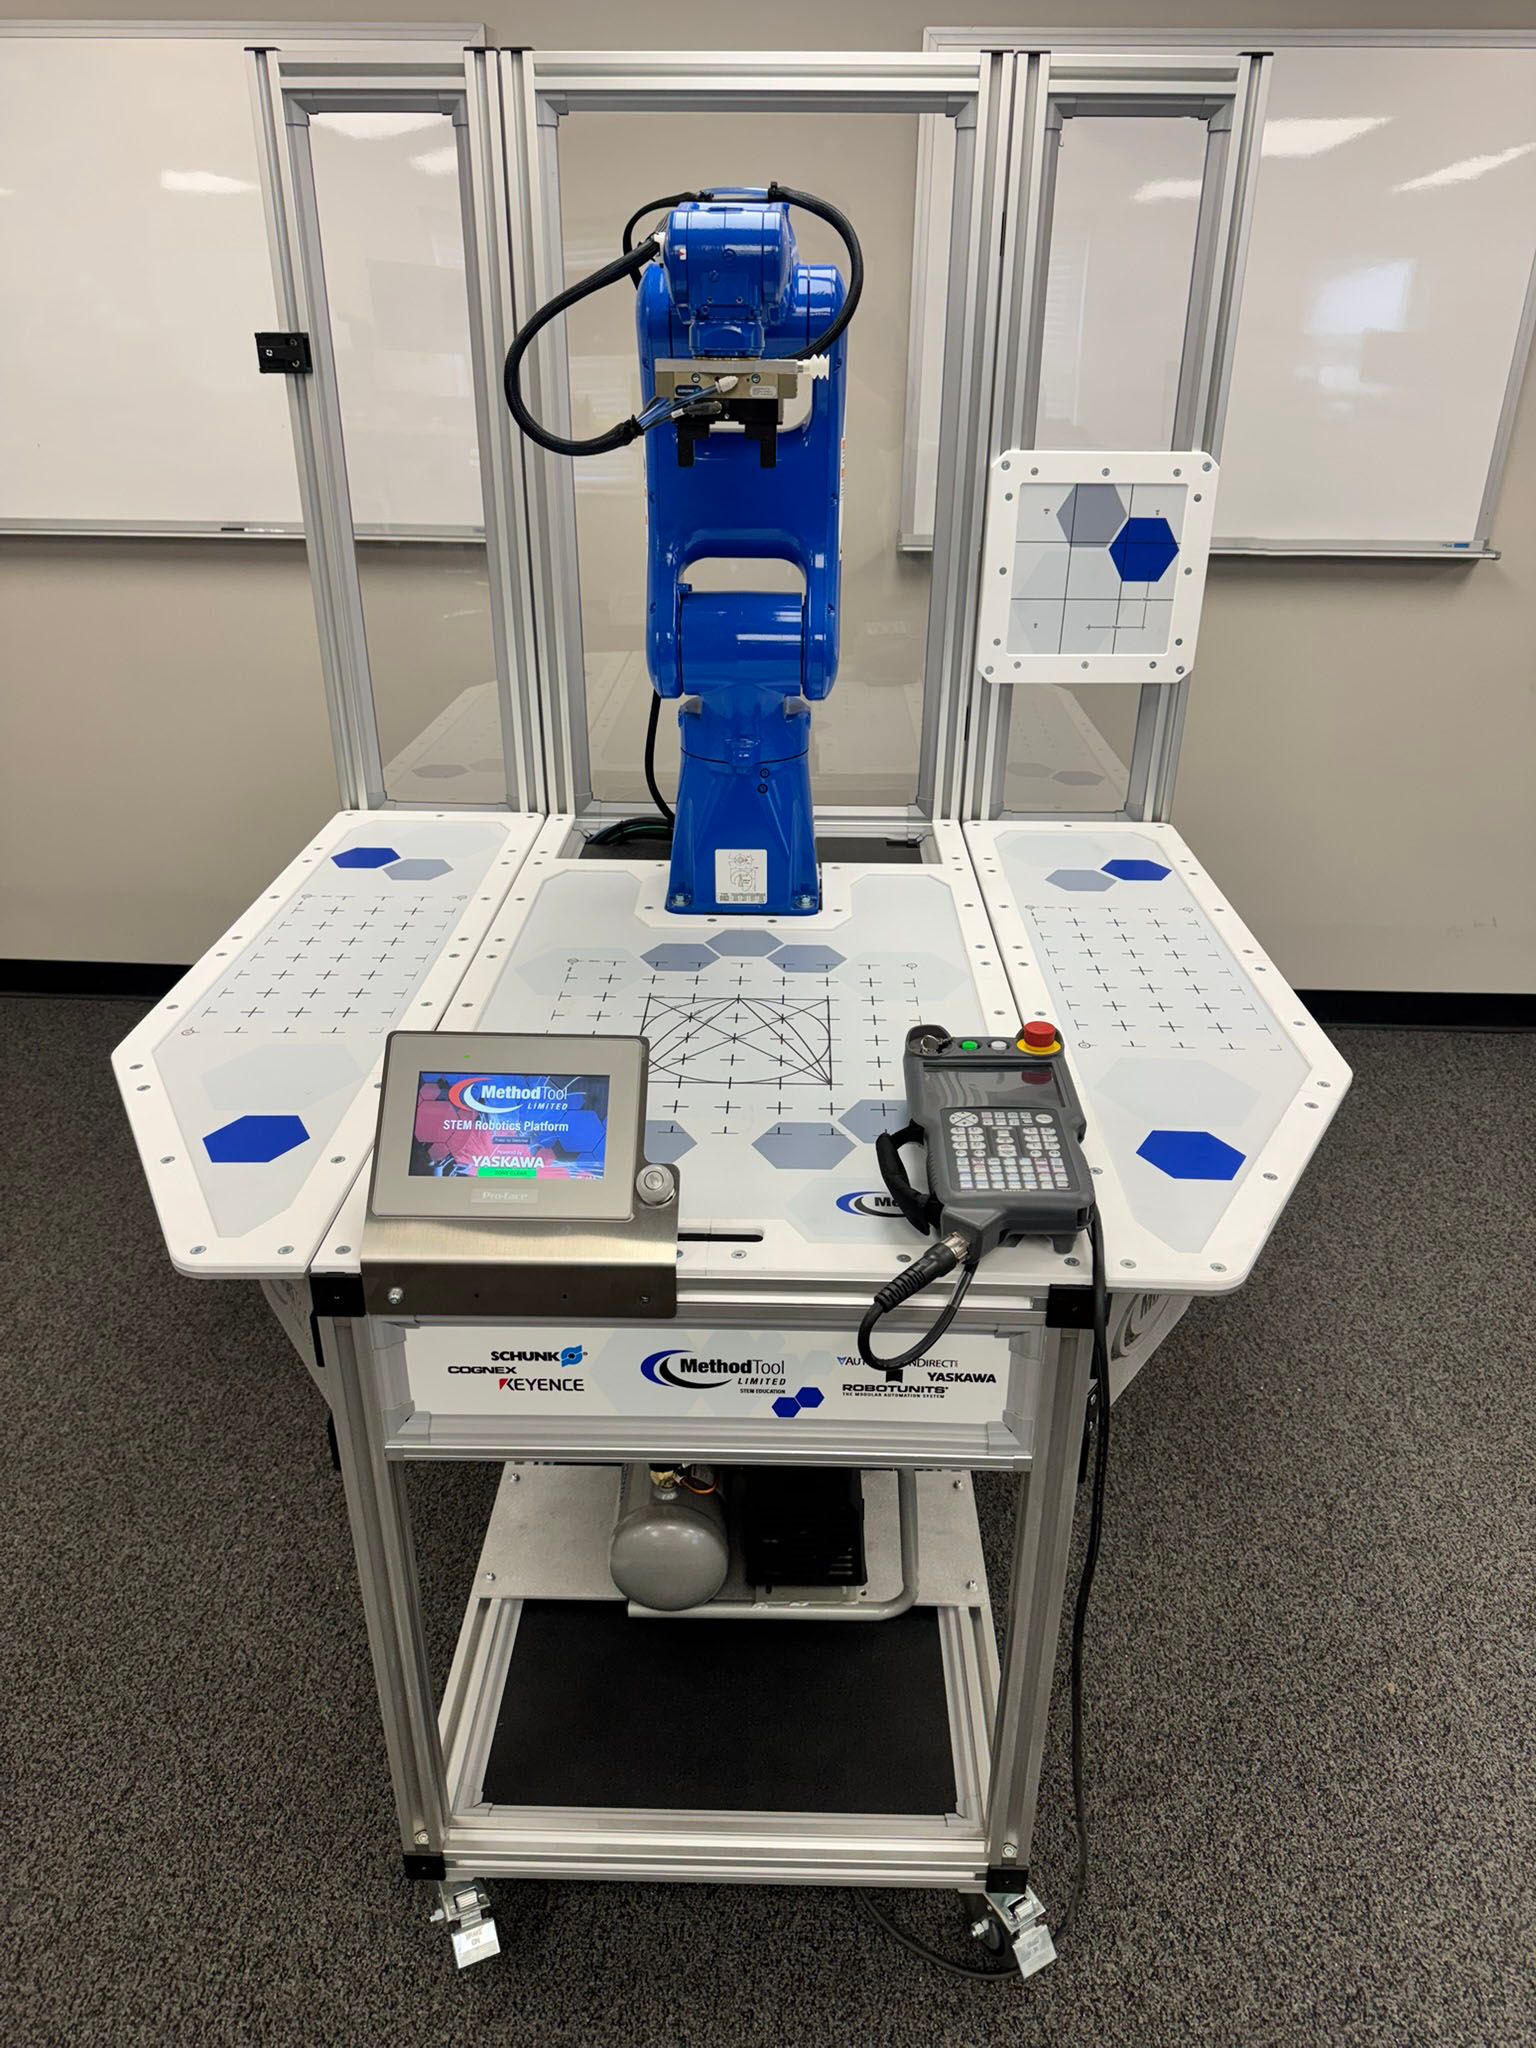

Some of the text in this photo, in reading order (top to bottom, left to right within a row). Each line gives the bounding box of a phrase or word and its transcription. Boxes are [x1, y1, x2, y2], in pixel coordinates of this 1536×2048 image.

[481, 1085, 568, 1100] MethodTool
[527, 1102, 568, 1111] LIMITED
[443, 1119, 569, 1132] STEM Robotics Platform
[472, 1155, 545, 1168] YASKAWA
[491, 1351, 561, 1361] SCHUNK
[447, 1366, 517, 1374] COGNEX
[680, 1358, 785, 1375] MethodTool
[738, 1377, 786, 1385] LIMITED
[927, 1372, 997, 1383] YASKAWA
[499, 1378, 585, 1391] KEYENCE
